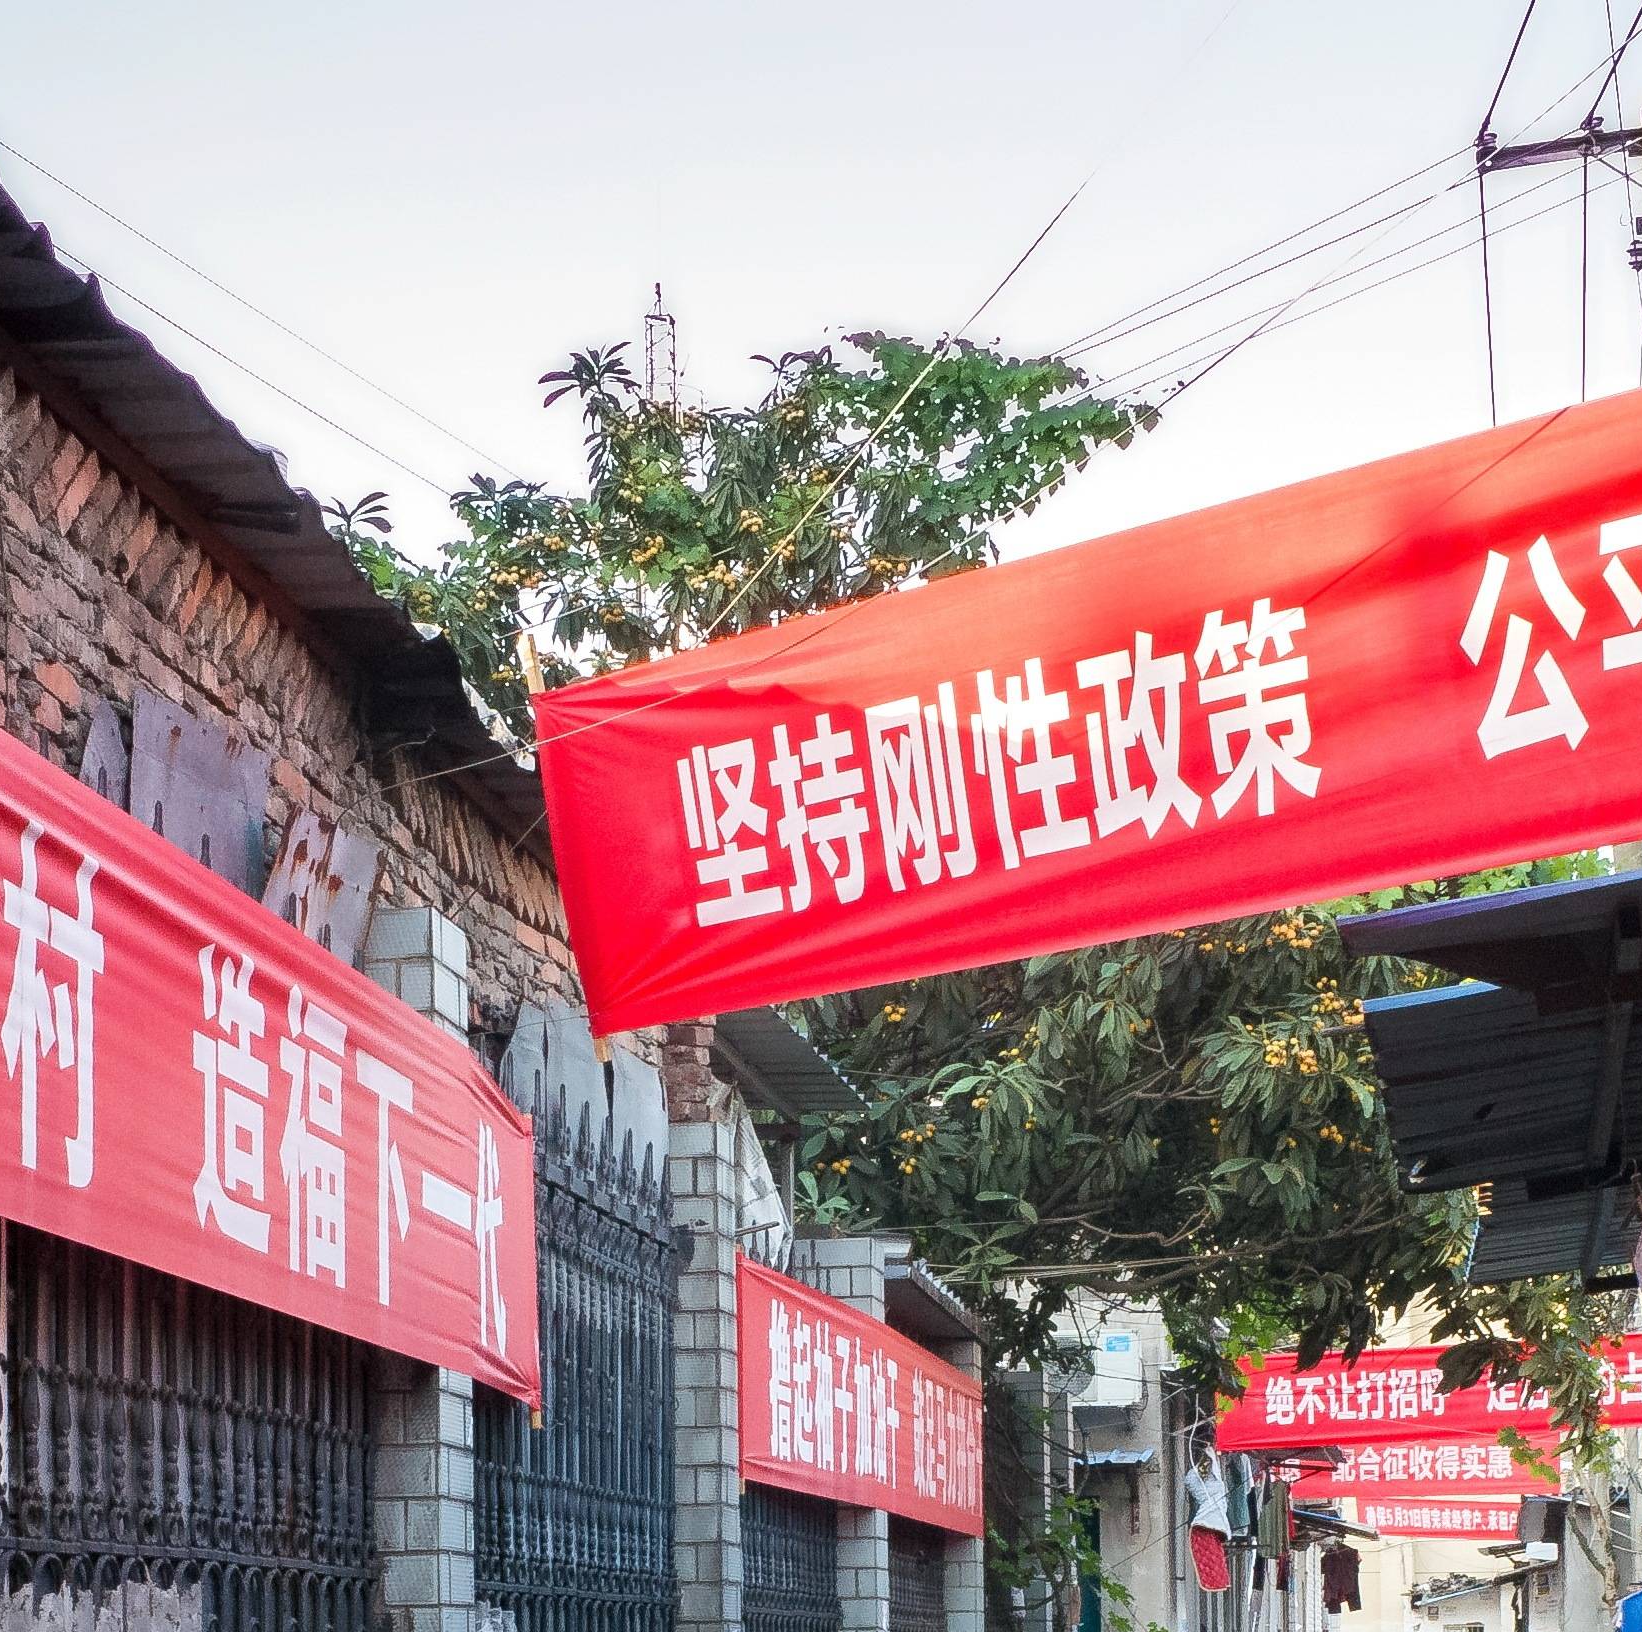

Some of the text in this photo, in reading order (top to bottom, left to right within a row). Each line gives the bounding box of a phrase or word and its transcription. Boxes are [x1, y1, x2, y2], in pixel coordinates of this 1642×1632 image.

[675, 598, 1324, 929] 坚持刚性政策
[191, 938, 508, 1358] 造福下一代
[768, 1298, 900, 1491] 撸起袖子加油干
[1265, 1367, 1451, 1425] 绝不让打招呼
[1330, 1444, 1514, 1482] 配合征收得实惠
